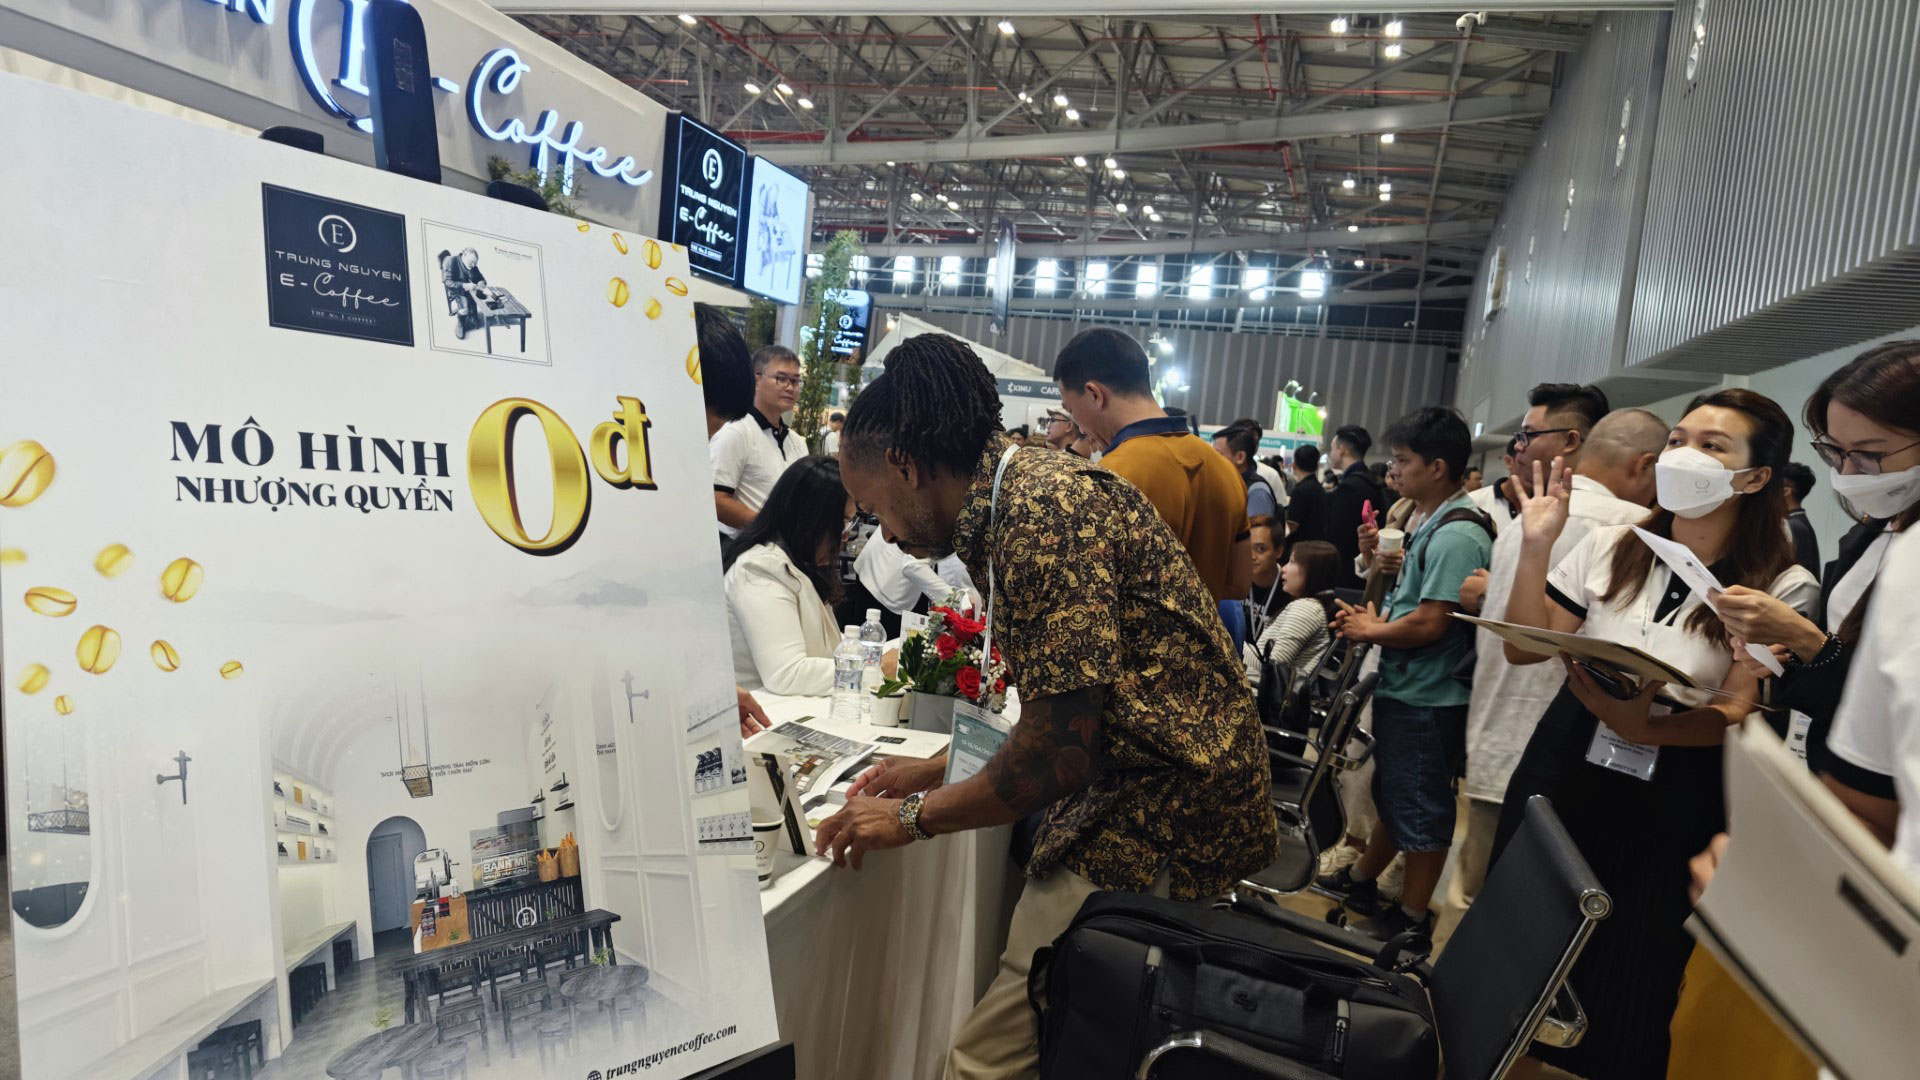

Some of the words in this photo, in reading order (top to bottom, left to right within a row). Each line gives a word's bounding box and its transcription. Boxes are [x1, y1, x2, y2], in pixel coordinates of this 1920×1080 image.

[680, 184, 707, 204] TRUNG
[708, 197, 737, 218] NGUYEN
[275, 250, 331, 268] TRUNG
[338, 262, 402, 282] NGUYEN
[311, 309, 325, 317] THE
[169, 415, 275, 467] MÔ
[297, 424, 450, 478] HÌNH
[175, 475, 337, 512] NHƯỢNG
[344, 477, 453, 514] QUYỀN
[605, 1024, 738, 1080] trungnguyenecoffee.com
